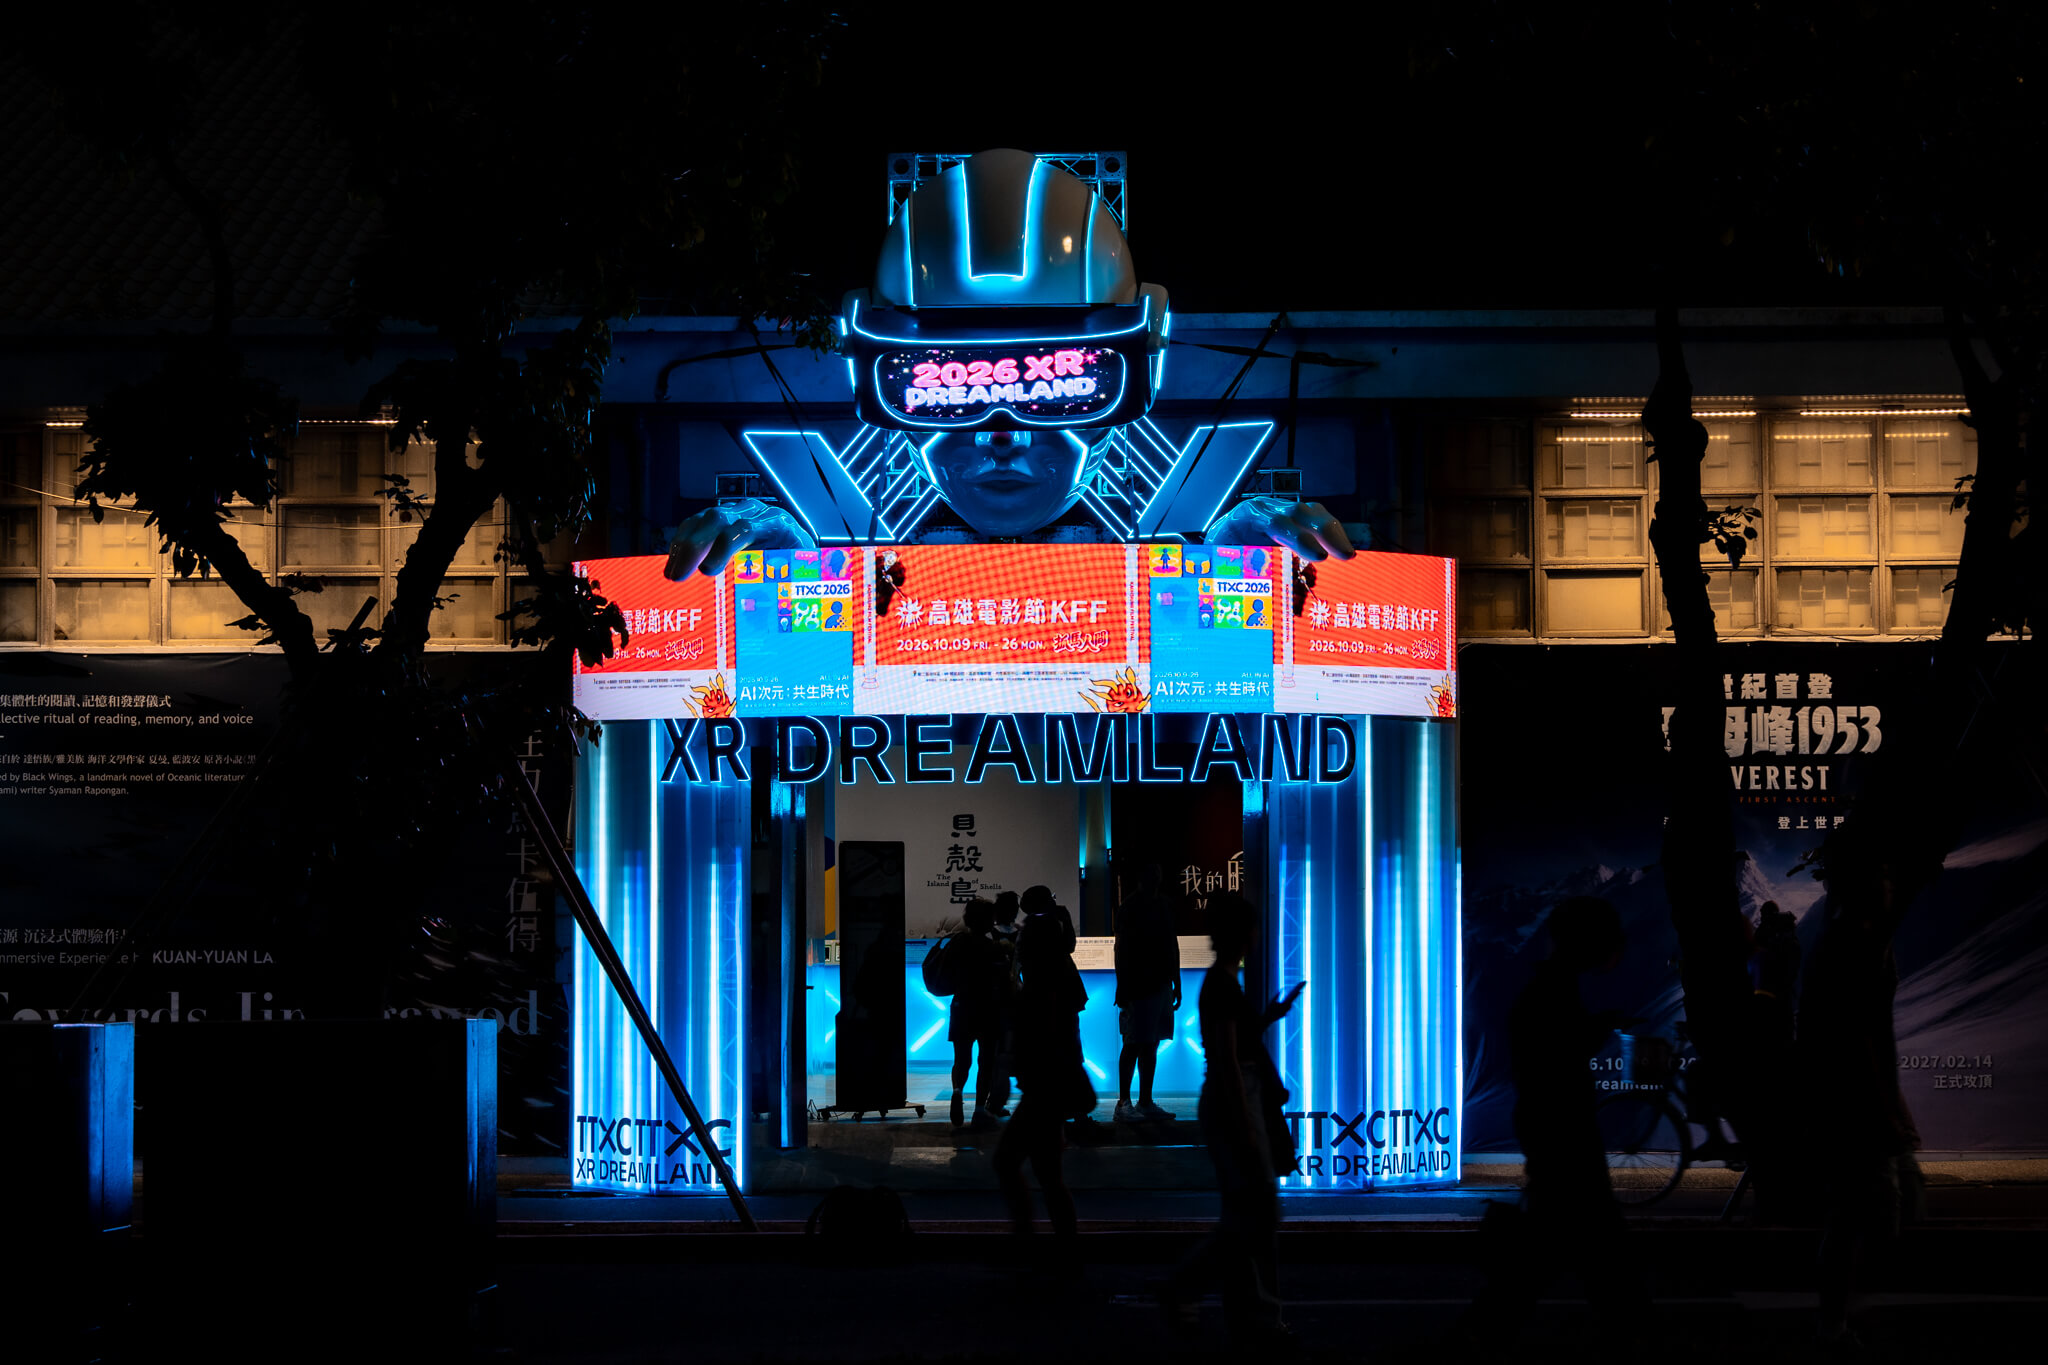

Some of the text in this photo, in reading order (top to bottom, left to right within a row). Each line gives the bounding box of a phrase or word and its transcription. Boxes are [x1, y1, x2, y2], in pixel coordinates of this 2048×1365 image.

[912, 350, 1085, 388] 2026 XR
[905, 377, 1097, 407] DREAMLAND
[823, 584, 850, 595] 2026
[1244, 582, 1271, 593] 2026
[896, 638, 971, 651] 2026.10.09
[973, 641, 991, 650] FRI.
[1002, 638, 1018, 650] 26
[1309, 639, 1364, 654] 2026.10.09
[1383, 643, 1394, 654] 26
[636, 647, 645, 658] 26
[0, 712, 254, 727] lective ritual of reading, memory, and voice
[1661, 705, 1883, 758] 母峰1953
[661, 713, 1357, 785] XR DREAMLAND
[9, 773, 21, 784] by
[23, 773, 46, 783] Black
[48, 773, 77, 785] Wings,
[79, 775, 85, 783] a
[87, 773, 127, 783] landmark
[130, 773, 153, 783] novel
[155, 773, 166, 783] of
[167, 773, 202, 783] Oceanic
[1730, 765, 1830, 790] VEREST
[20, 786, 46, 795] writer
[49, 786, 82, 797] Syaman
[85, 786, 129, 797] Rapongan.
[152, 950, 248, 964] KUAN-YUAN
[1934, 1074, 1993, 1089] 正式攻頂
[576, 1157, 596, 1180] XR
[1332, 1150, 1451, 1177] DREAMLAND
